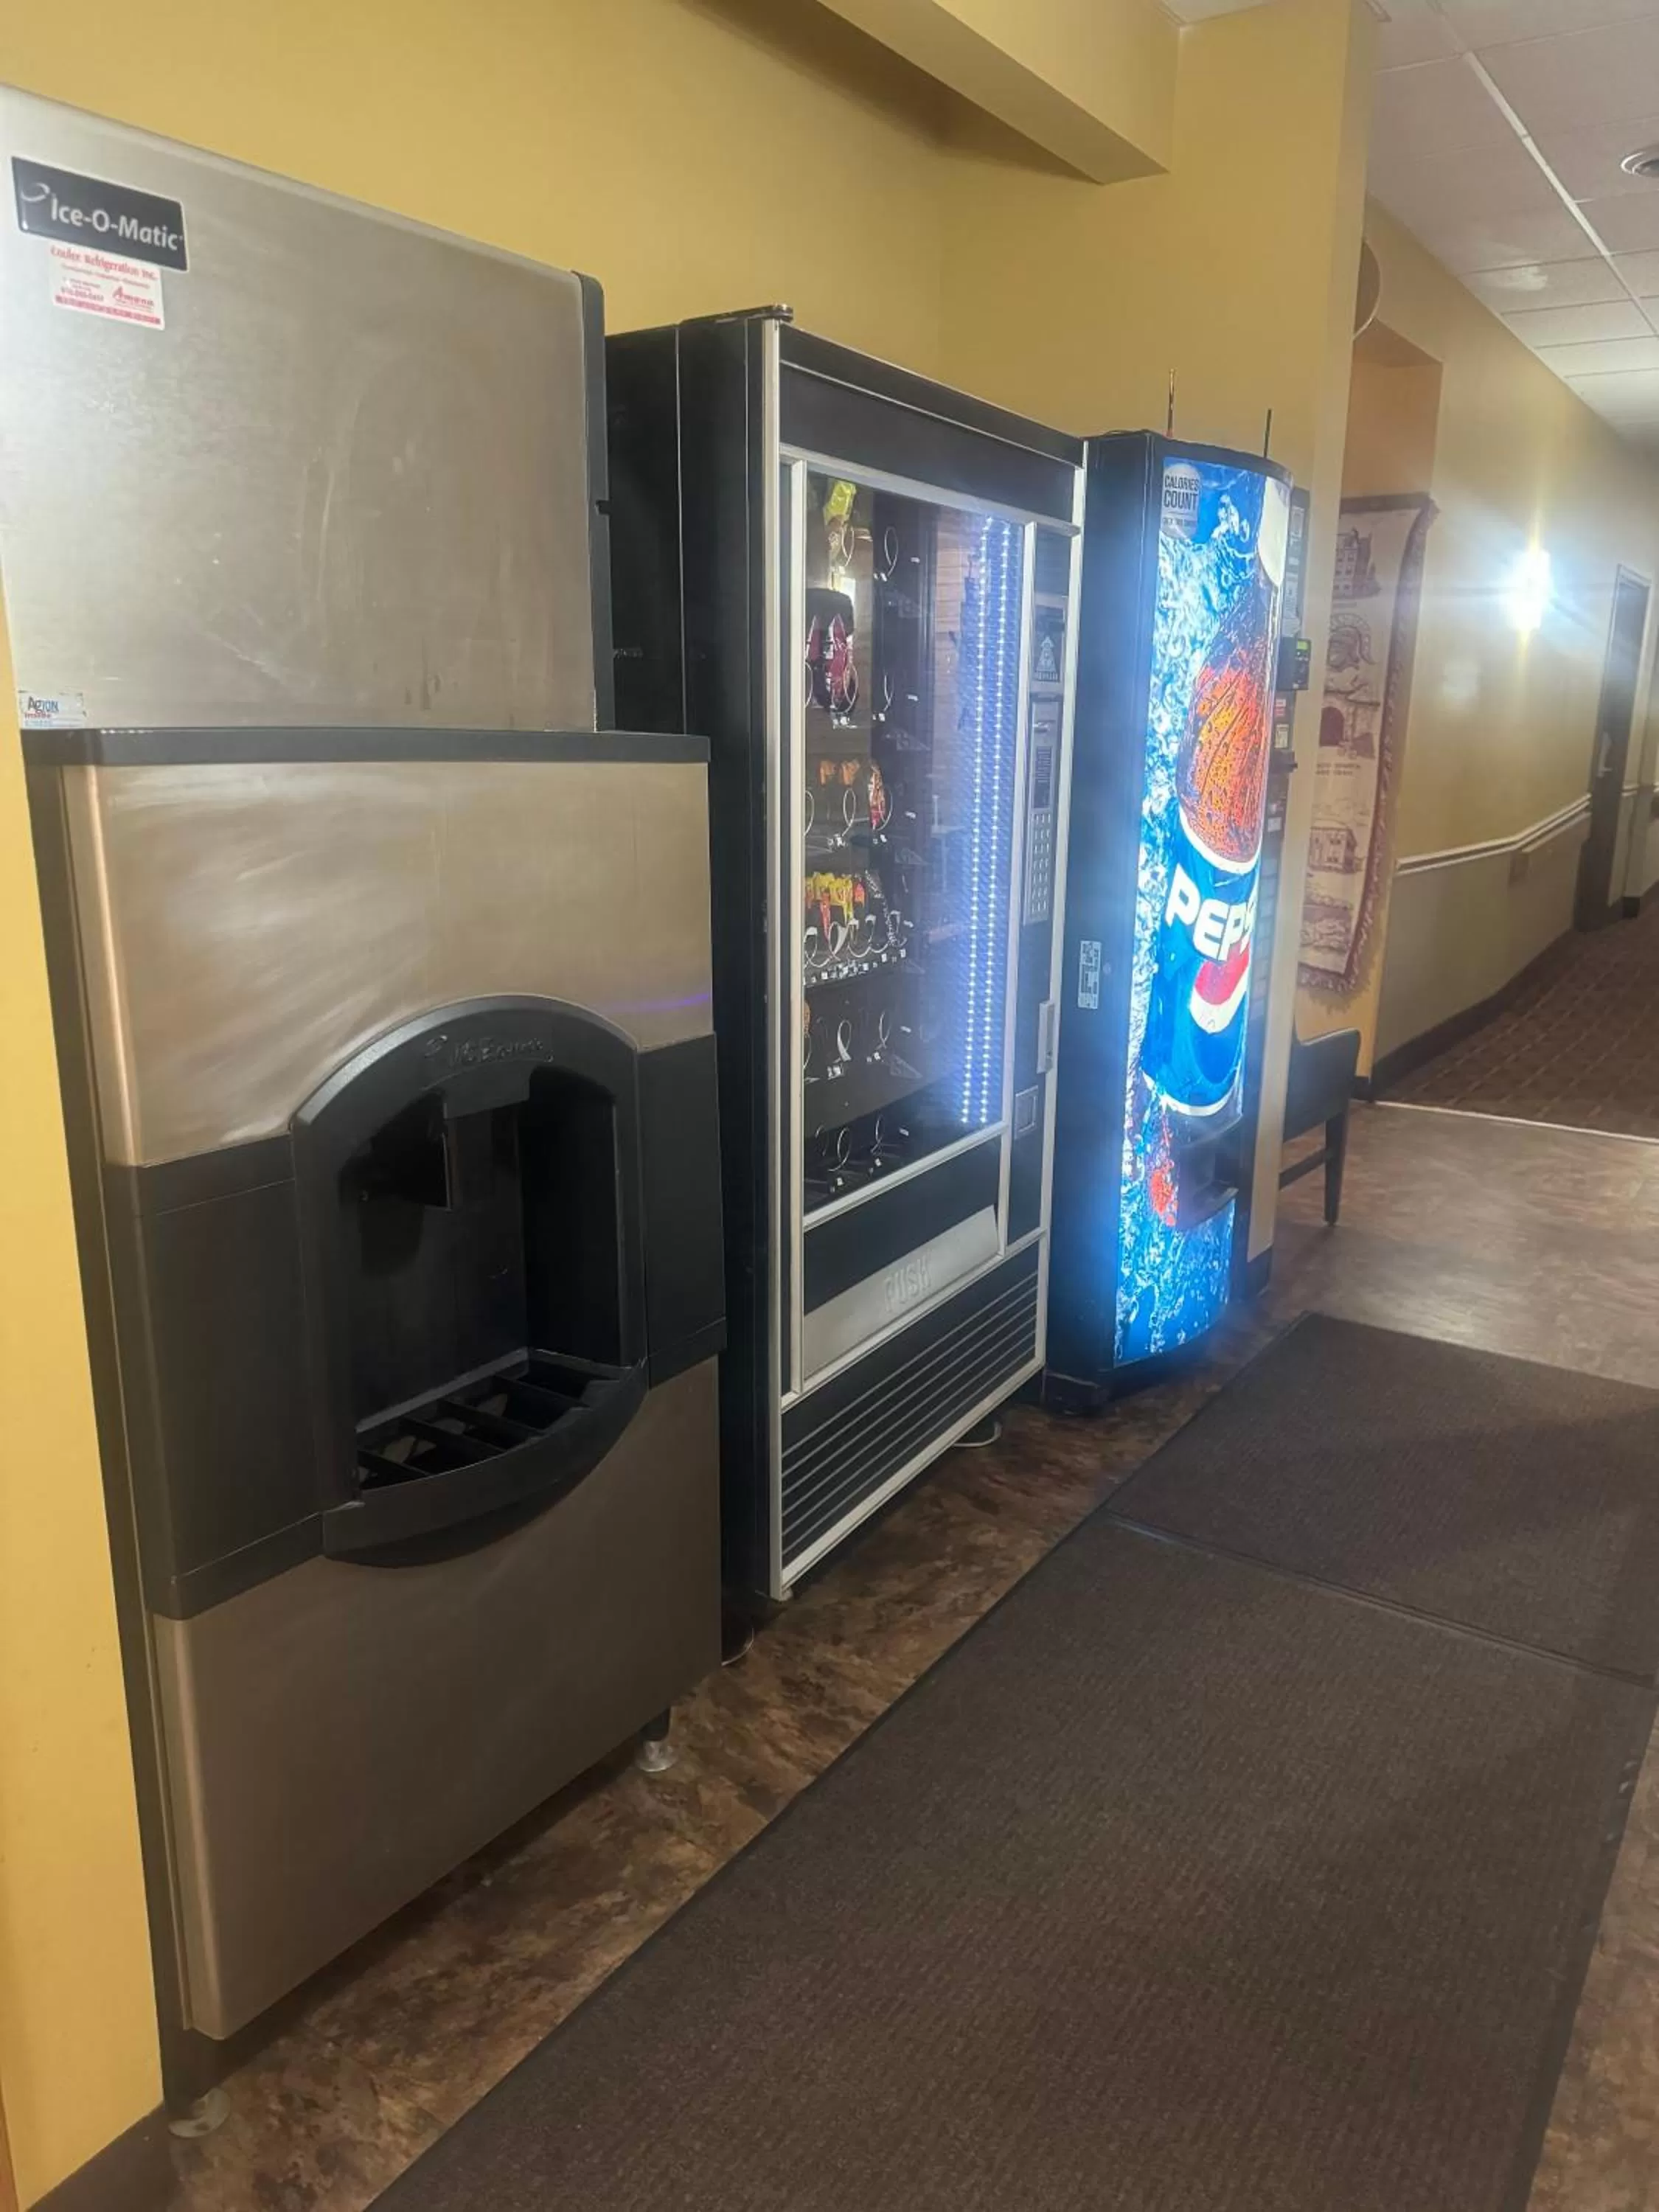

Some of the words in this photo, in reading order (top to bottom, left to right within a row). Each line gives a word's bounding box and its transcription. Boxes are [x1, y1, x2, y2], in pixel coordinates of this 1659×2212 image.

[51, 197, 178, 251] Ice-O-Matic
[1164, 490, 1198, 510] COUNT
[1165, 474, 1199, 491] CALORIES
[885, 1253, 931, 1312] PUSH
